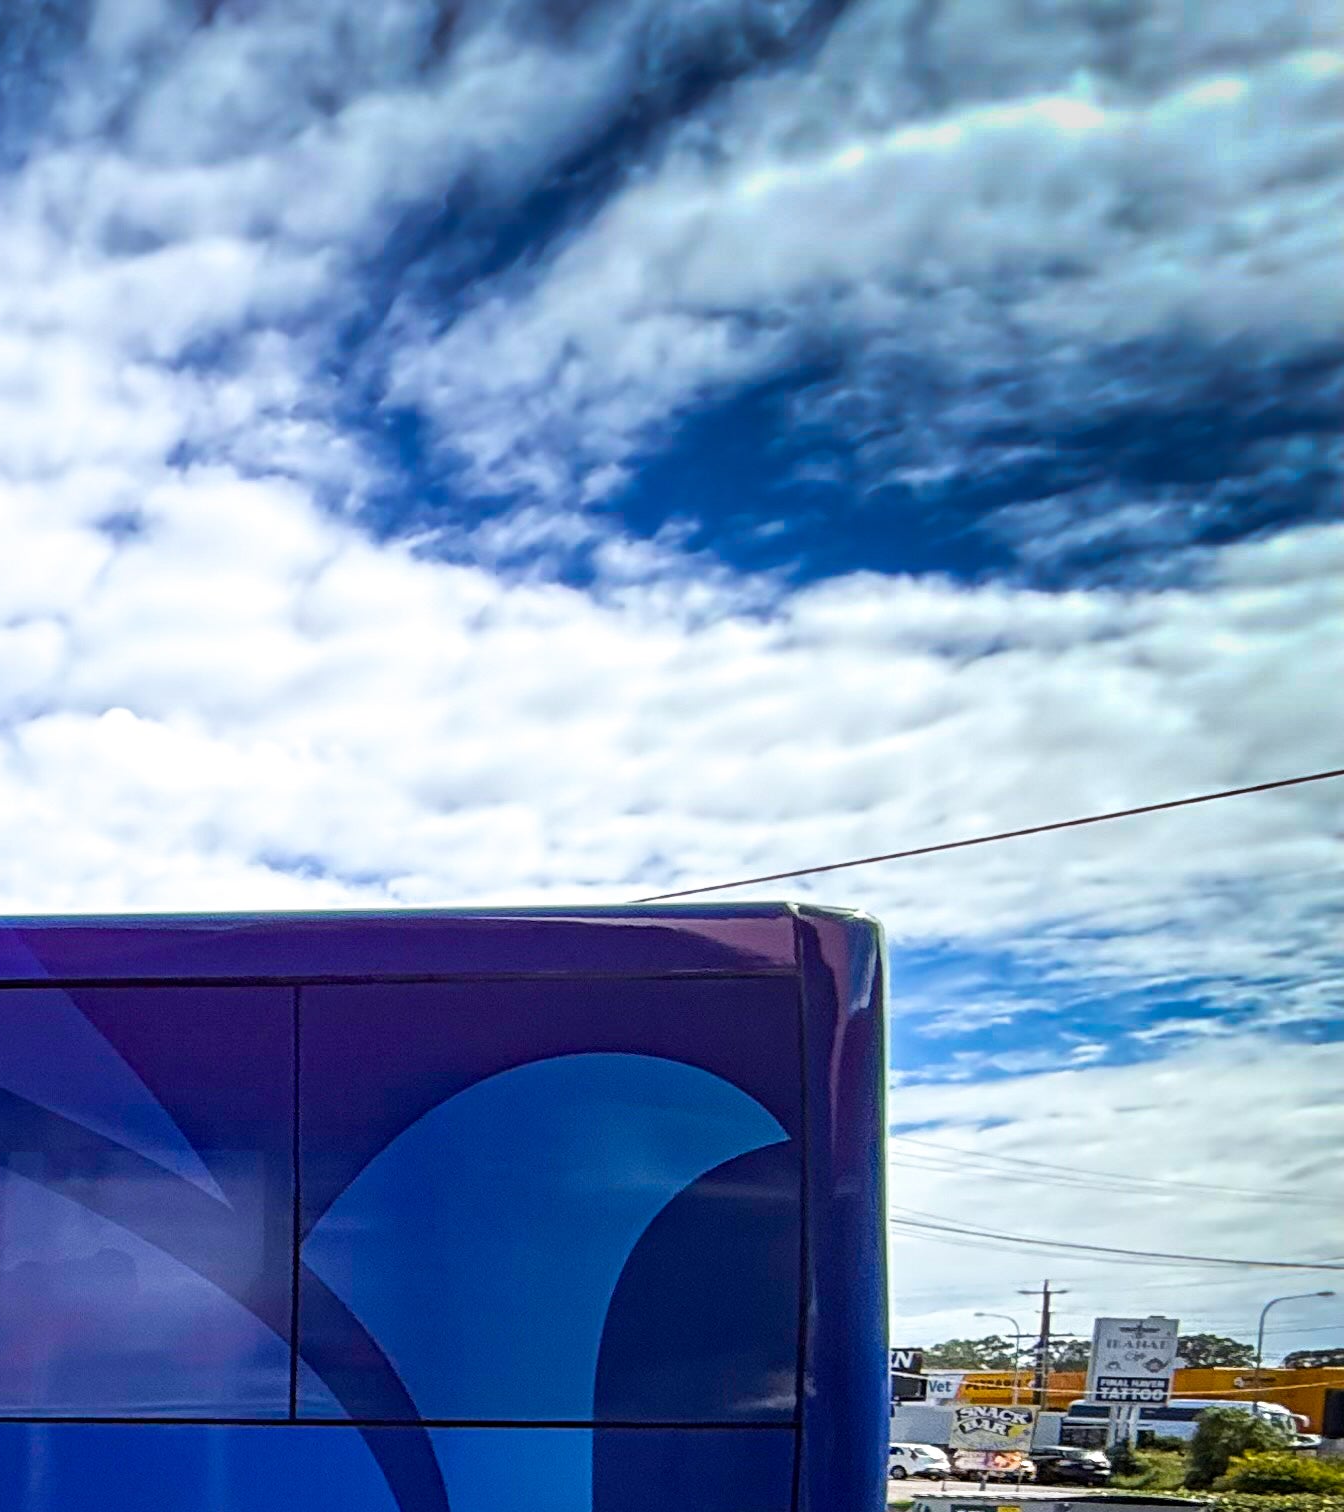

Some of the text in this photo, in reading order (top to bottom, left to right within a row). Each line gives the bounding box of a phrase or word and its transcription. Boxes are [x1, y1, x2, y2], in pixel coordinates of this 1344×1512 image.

[928, 1381, 953, 1393] Vet
[1099, 1387, 1165, 1400] TATTOO
[960, 1406, 1029, 1424] SNACK
[964, 1419, 1007, 1436] BAR
